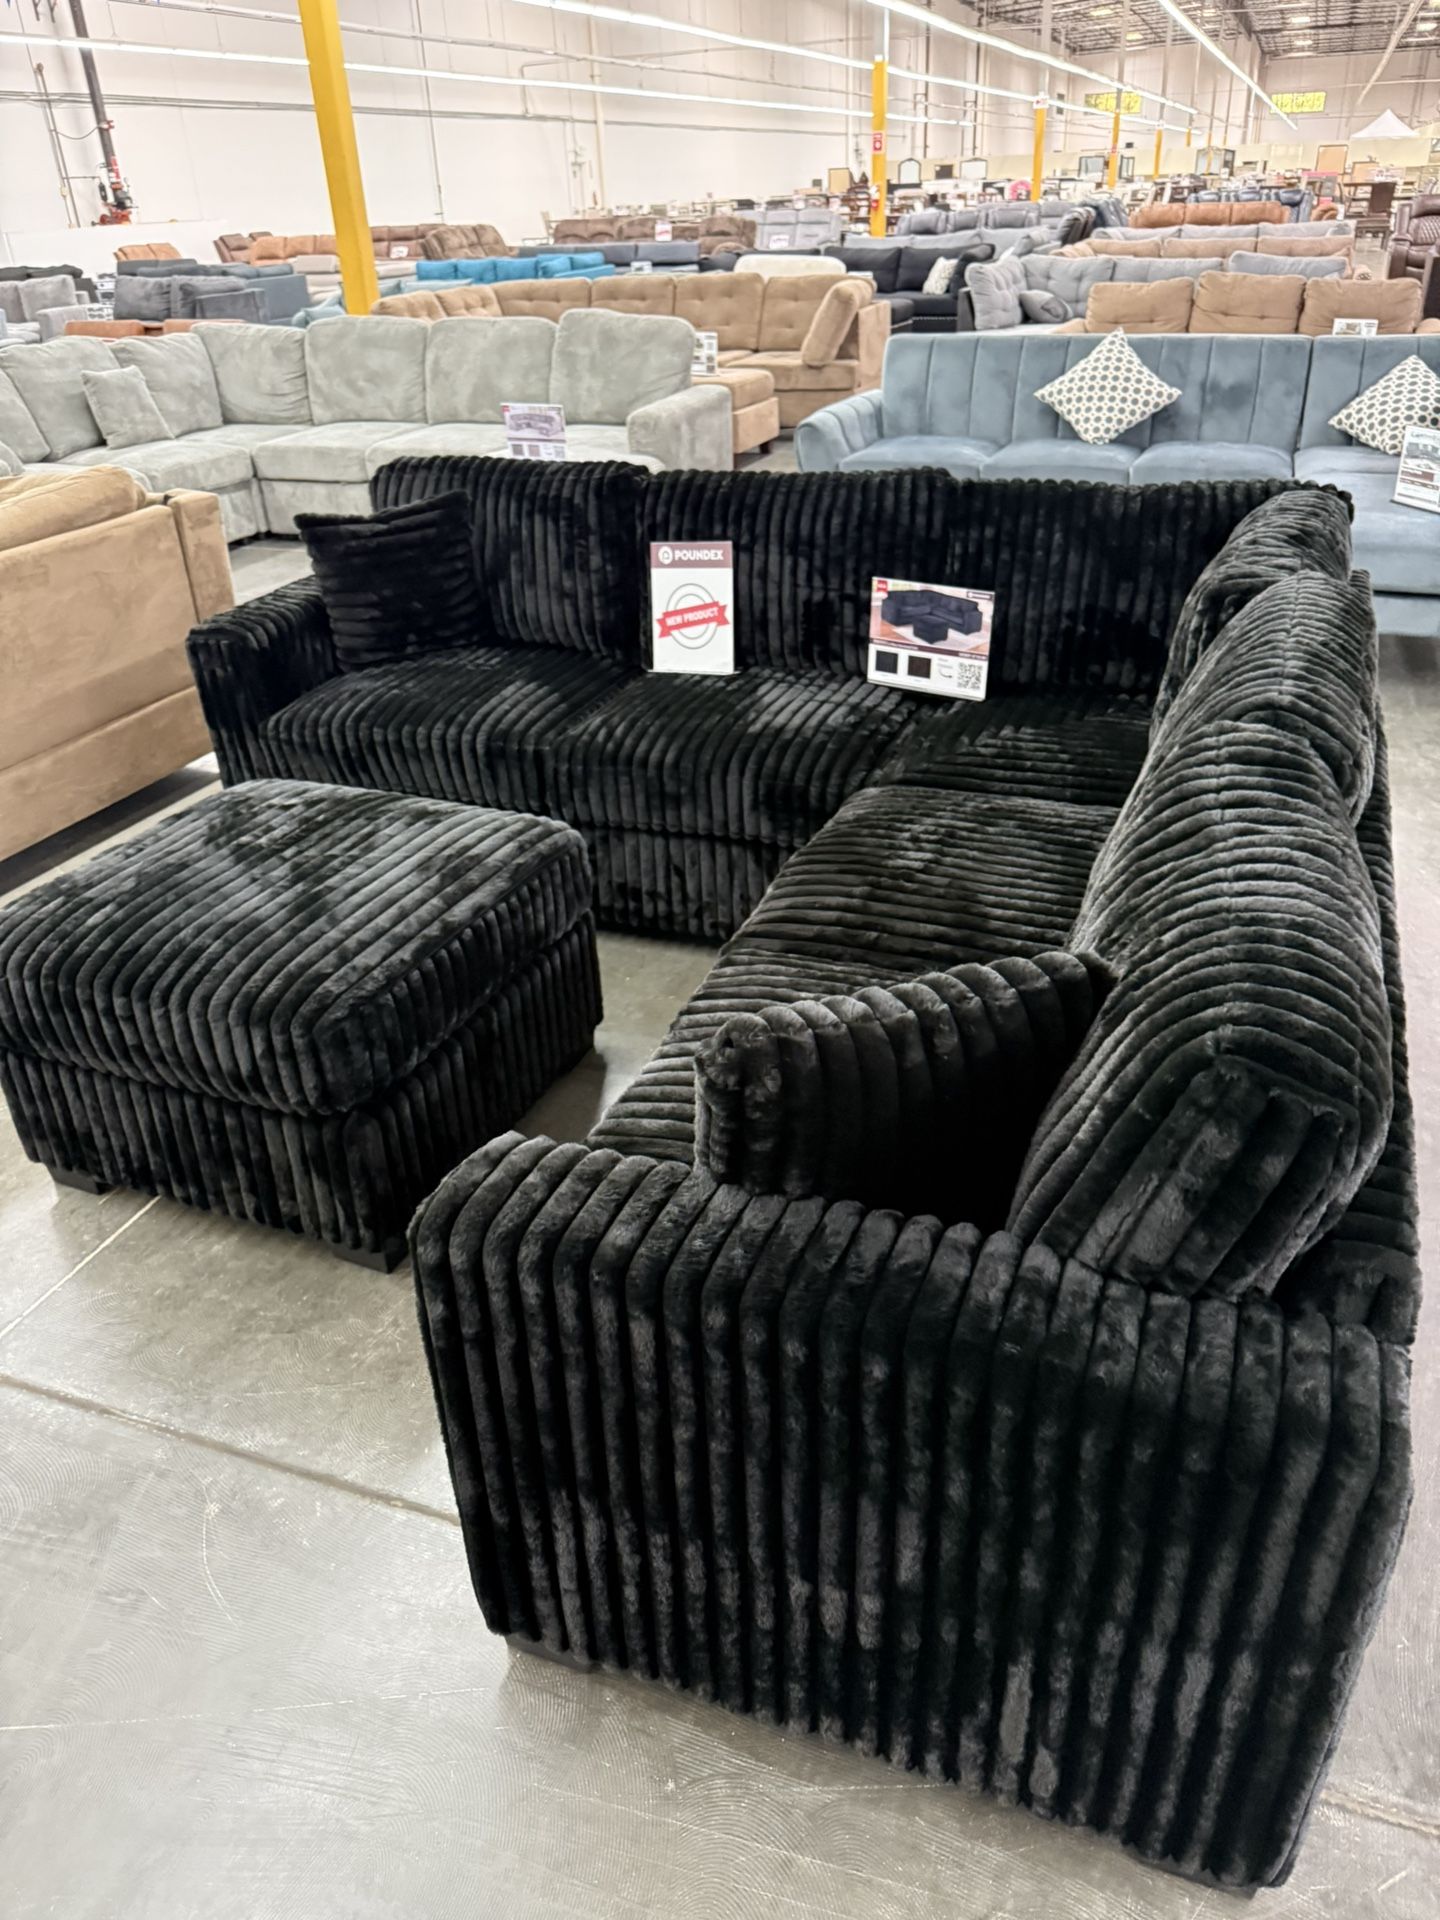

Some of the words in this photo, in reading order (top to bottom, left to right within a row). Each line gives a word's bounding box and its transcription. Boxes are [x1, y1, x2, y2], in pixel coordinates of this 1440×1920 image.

[674, 549, 724, 561] POUNDEX
[665, 615, 682, 626] NEW
[683, 607, 719, 623] PRODUCT
